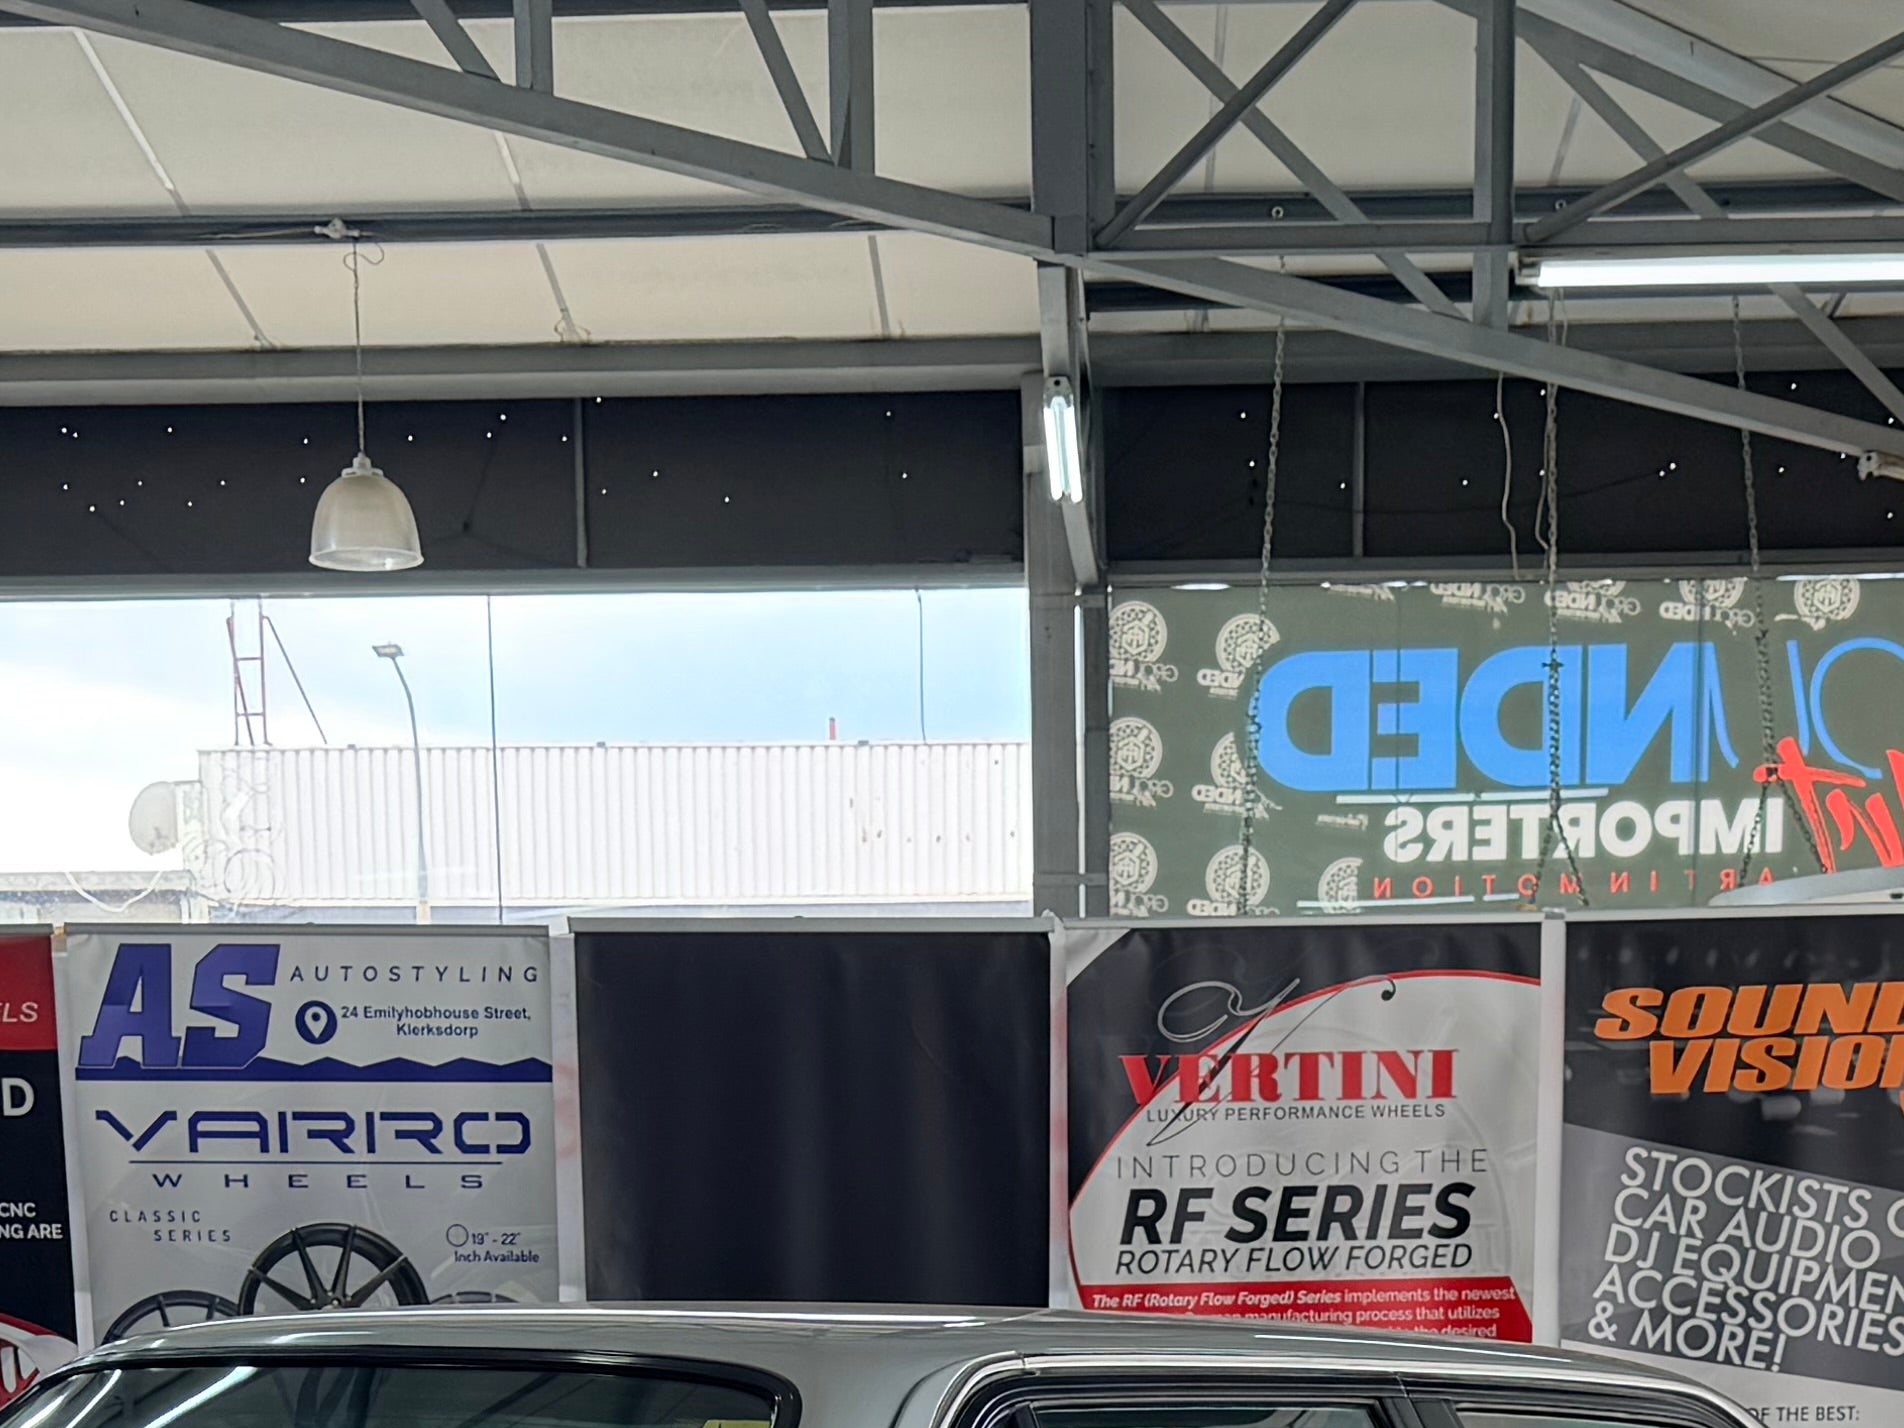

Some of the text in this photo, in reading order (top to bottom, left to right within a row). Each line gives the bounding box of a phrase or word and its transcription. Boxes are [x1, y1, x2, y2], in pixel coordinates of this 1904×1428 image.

[290, 966, 538, 982] AUTOSTYLING
[78, 944, 280, 1067] AS
[341, 1006, 531, 1022] 24 Emilyhobhouse Street,
[397, 1023, 478, 1039] Klerksdorp
[1118, 1049, 1459, 1105] VERTINI
[1147, 1104, 1445, 1123] LUXURY PERFORMANCE WHEELS
[1117, 1148, 1488, 1180] INTRODUCING THE
[153, 1174, 483, 1189] WHEELS
[1620, 1147, 1871, 1229] STOCKISTS
[110, 1211, 201, 1223] CLASSIC
[1120, 1183, 1475, 1245] RF SERIES
[27, 1224, 62, 1238] ARE
[153, 1230, 231, 1242] SERIES
[1614, 1188, 1881, 1270] CAR AUDIO
[454, 1250, 539, 1263] Inch Available
[1605, 1224, 1660, 1270] DJ
[1116, 1244, 1473, 1275] ROTARY FLOW FORGED
[1092, 1286, 1515, 1310] The RF (Rotary Flow Forged) Series implements the newest
[1356, 1308, 1412, 1323] process
[1416, 1306, 1444, 1319] that
[1448, 1305, 1500, 1319] utilizes
[1588, 1300, 1786, 1373] & MORE!
[1776, 1407, 1809, 1422] THE
[1816, 1406, 1859, 1421] BEST:
